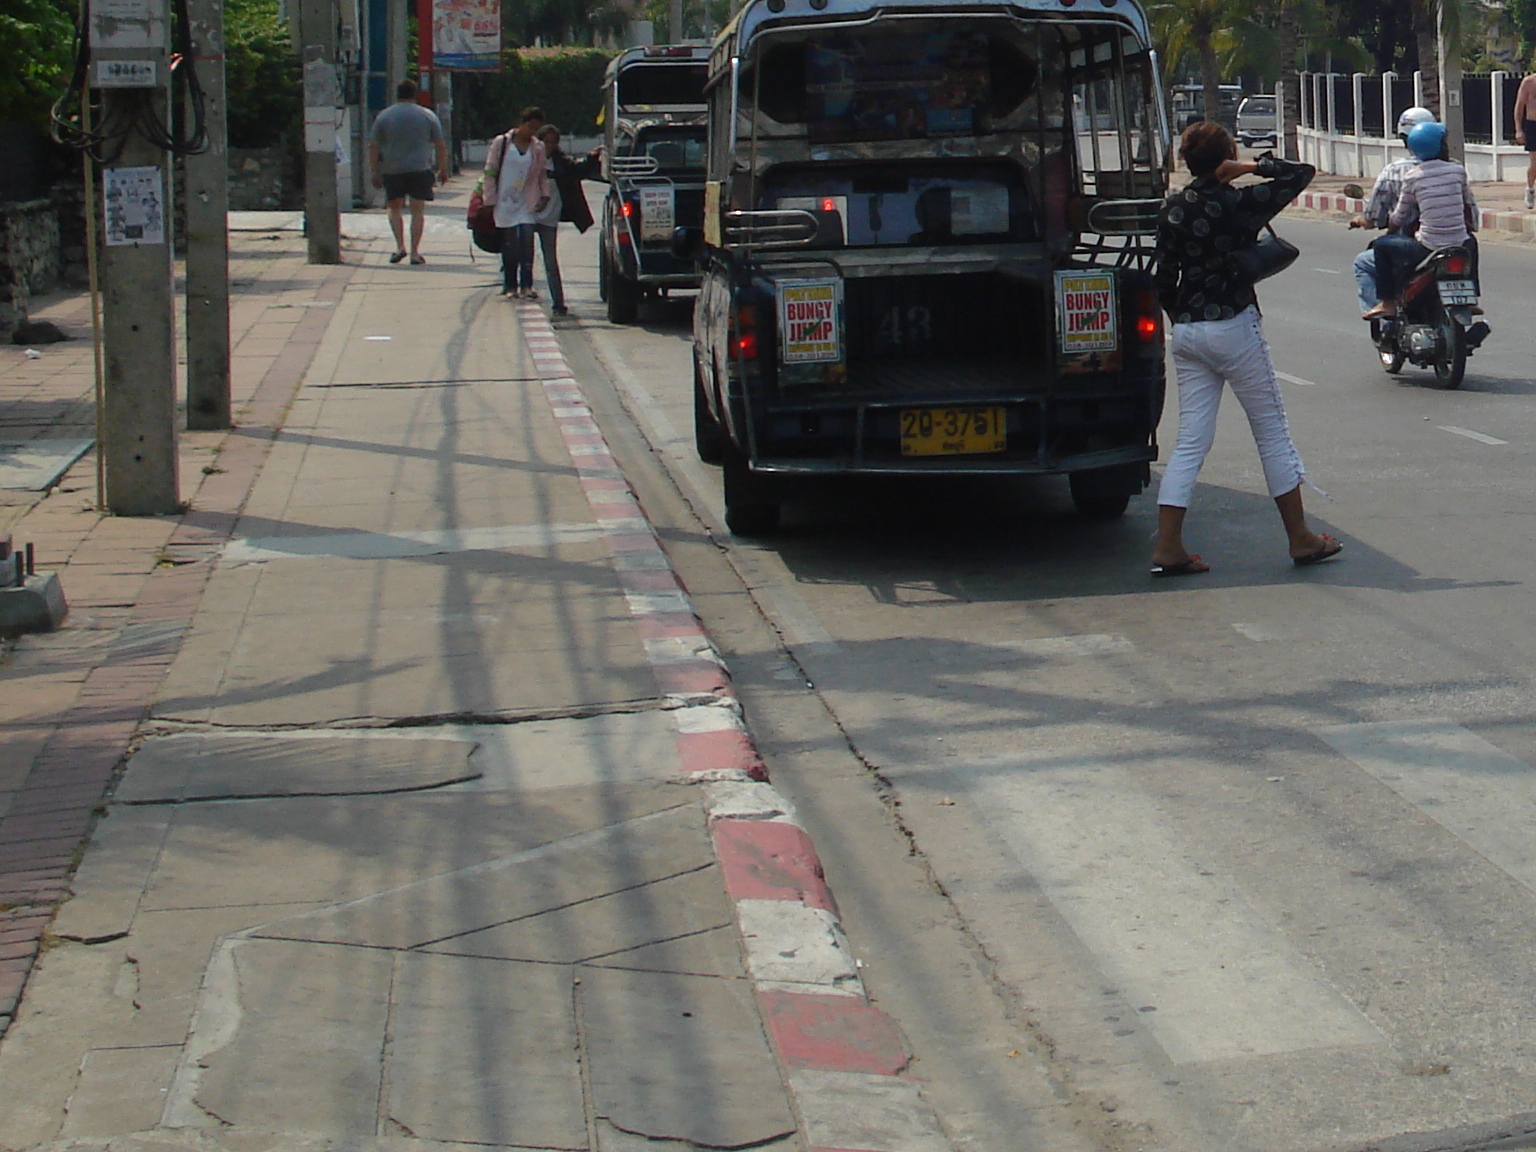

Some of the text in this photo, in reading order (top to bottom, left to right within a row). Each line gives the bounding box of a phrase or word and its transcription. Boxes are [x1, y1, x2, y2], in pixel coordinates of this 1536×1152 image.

[1066, 292, 1109, 311] BUNGY
[787, 302, 833, 321] BUNGY
[789, 321, 833, 341] JUMP
[1068, 311, 1110, 332] JUMP
